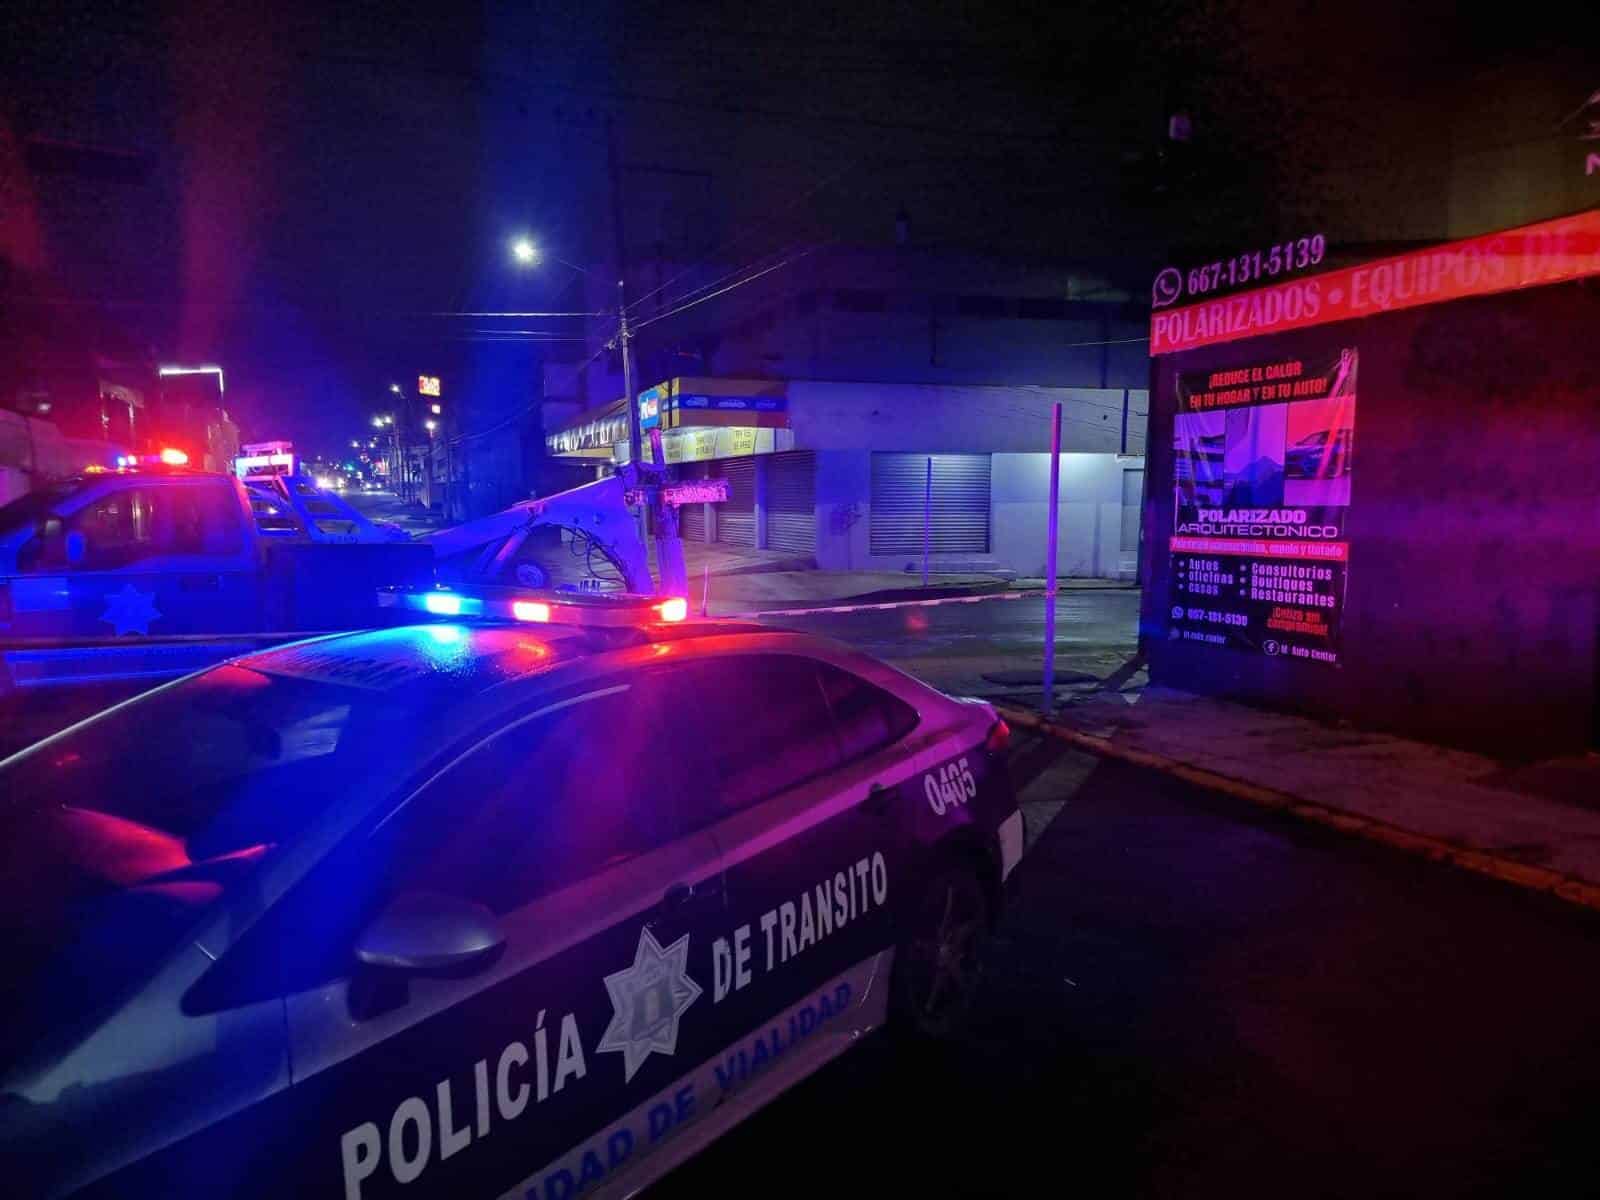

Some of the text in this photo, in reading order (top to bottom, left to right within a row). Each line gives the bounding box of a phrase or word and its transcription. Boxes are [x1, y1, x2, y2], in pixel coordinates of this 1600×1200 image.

[1187, 233, 1326, 296] 667-131-5139
[1153, 280, 1320, 347] POLARIZADOS
[1349, 237, 1506, 311] EQUIPOS
[1252, 367, 1264, 382] EL
[1266, 361, 1302, 379] CALOR
[1189, 395, 1201, 408] EN
[1203, 393, 1215, 406] TU
[1216, 390, 1250, 405] HOGAR
[1261, 386, 1276, 400] EN
[1278, 384, 1290, 397] TU
[1293, 378, 1327, 396] AUTO!
[1198, 509, 1307, 524] POLARIZADO
[1178, 523, 1338, 538] ARQUITECTONICO
[1189, 558, 1219, 571] Autos
[1252, 562, 1332, 580] Consultorios
[1252, 576, 1313, 592] Boutiques
[1251, 588, 1335, 607] Restaurantes
[924, 758, 978, 816] 0405
[339, 851, 888, 1200] POLICÍA DE TRANSITO
[650, 1089, 697, 1142] DE
[716, 983, 853, 1093] VIALIDAD
